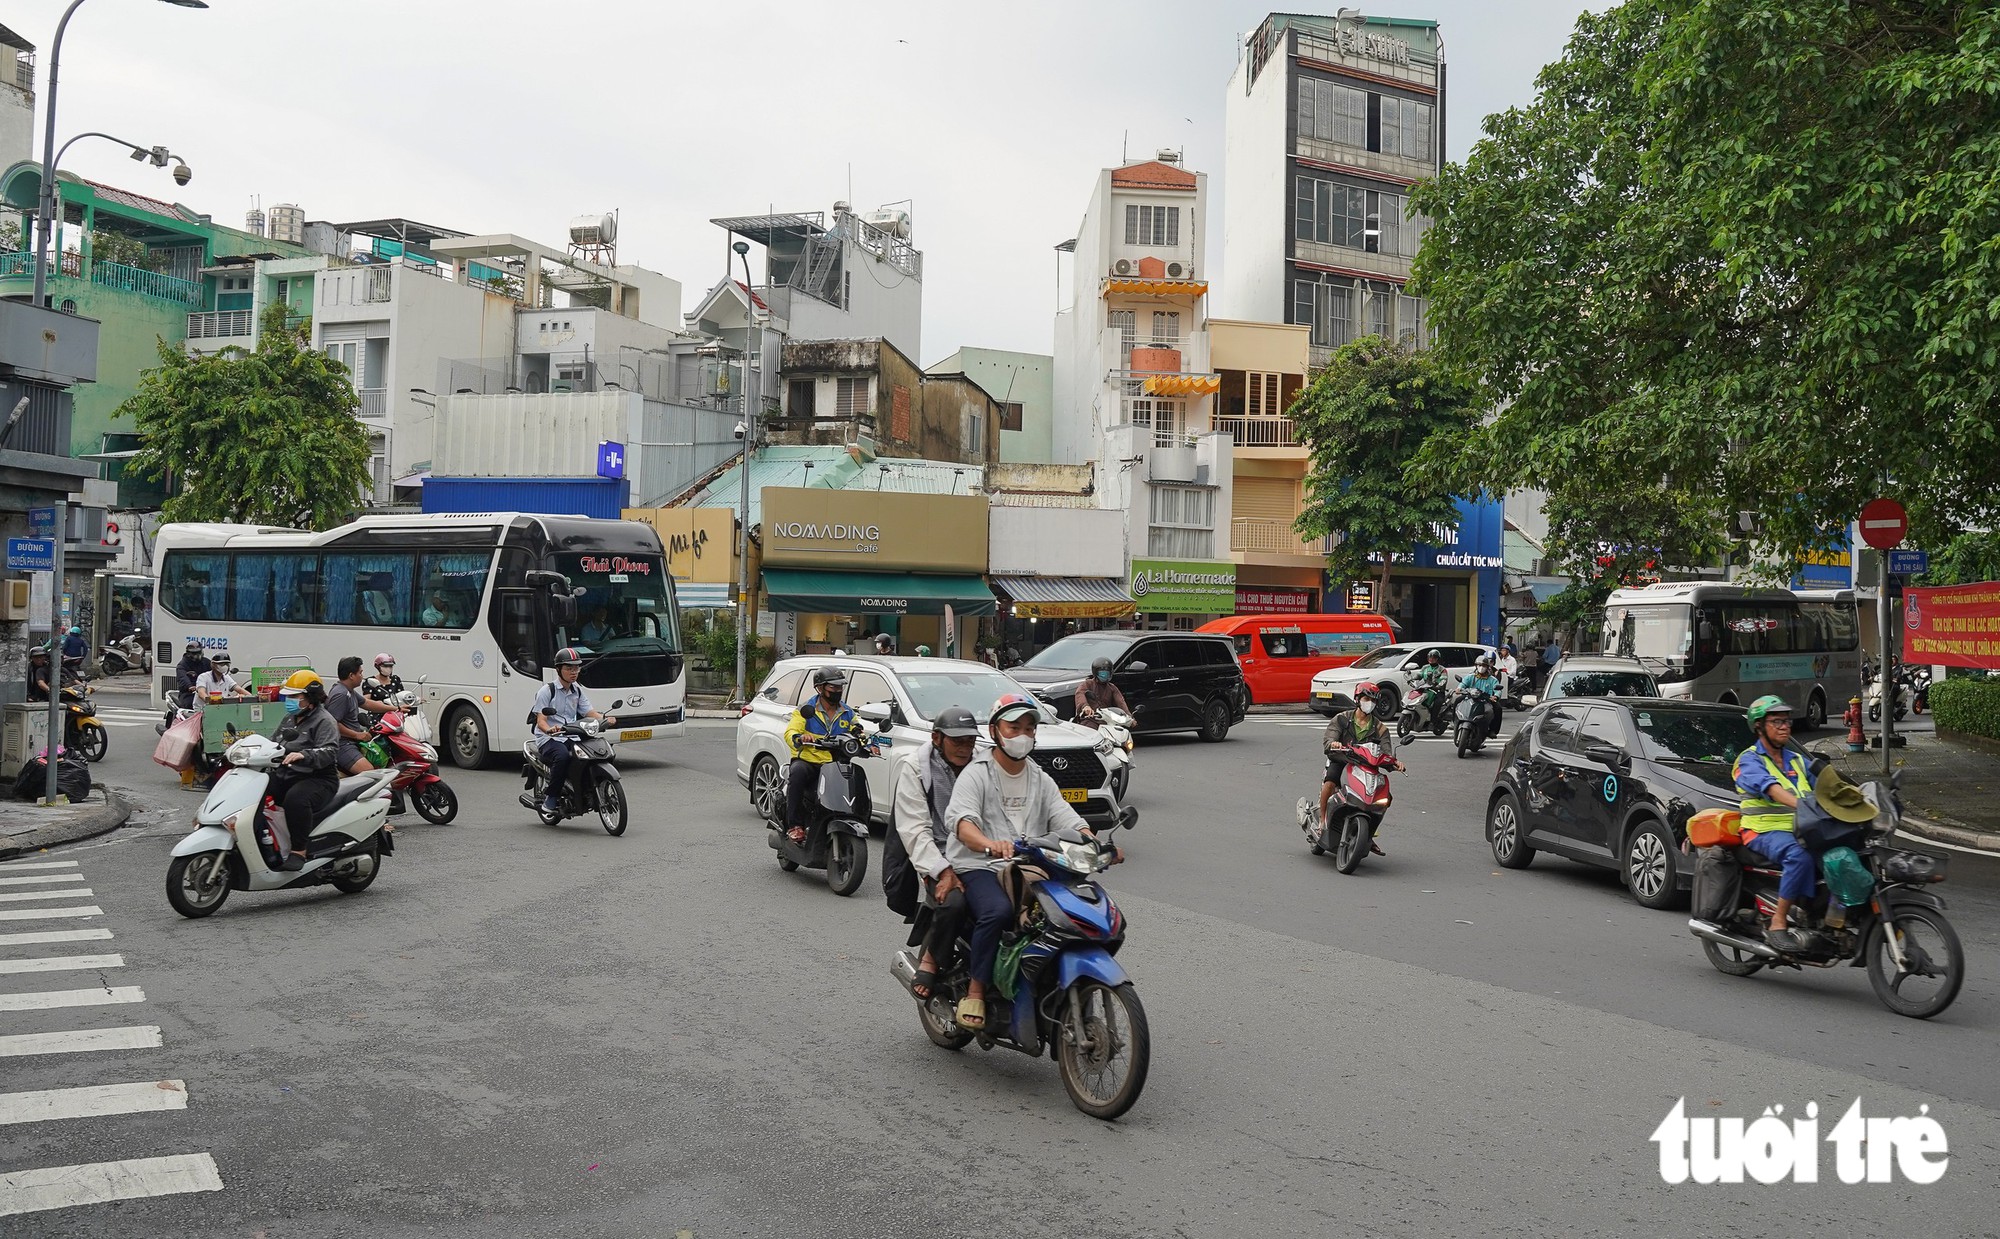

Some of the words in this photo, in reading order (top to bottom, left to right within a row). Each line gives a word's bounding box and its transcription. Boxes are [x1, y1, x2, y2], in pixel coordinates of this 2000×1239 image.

[774, 522, 880, 541] NOMADING
[17, 541, 44, 552] ĐƯỜNG
[856, 543, 879, 553] Café
[1436, 551, 1459, 566] CHUỖI
[1459, 551, 1471, 566] CẮT
[1472, 554, 1487, 567] TÓC
[1487, 557, 1503, 568] NAM
[1898, 553, 1920, 561] ĐƯỜNG
[580, 556, 611, 573] Thái
[612, 556, 651, 575] Phong
[1912, 561, 1923, 571] SÁU
[1164, 569, 1237, 586] Homemade
[860, 598, 908, 608] NOMADING
[1247, 594, 1259, 604] CHO
[1066, 607, 1080, 616] XE
[1953, 617, 1967, 632] THAM
[1976, 614, 1987, 632] CÁC
[421, 633, 450, 641] GLOBAL
[1061, 791, 1083, 801] 67.97
